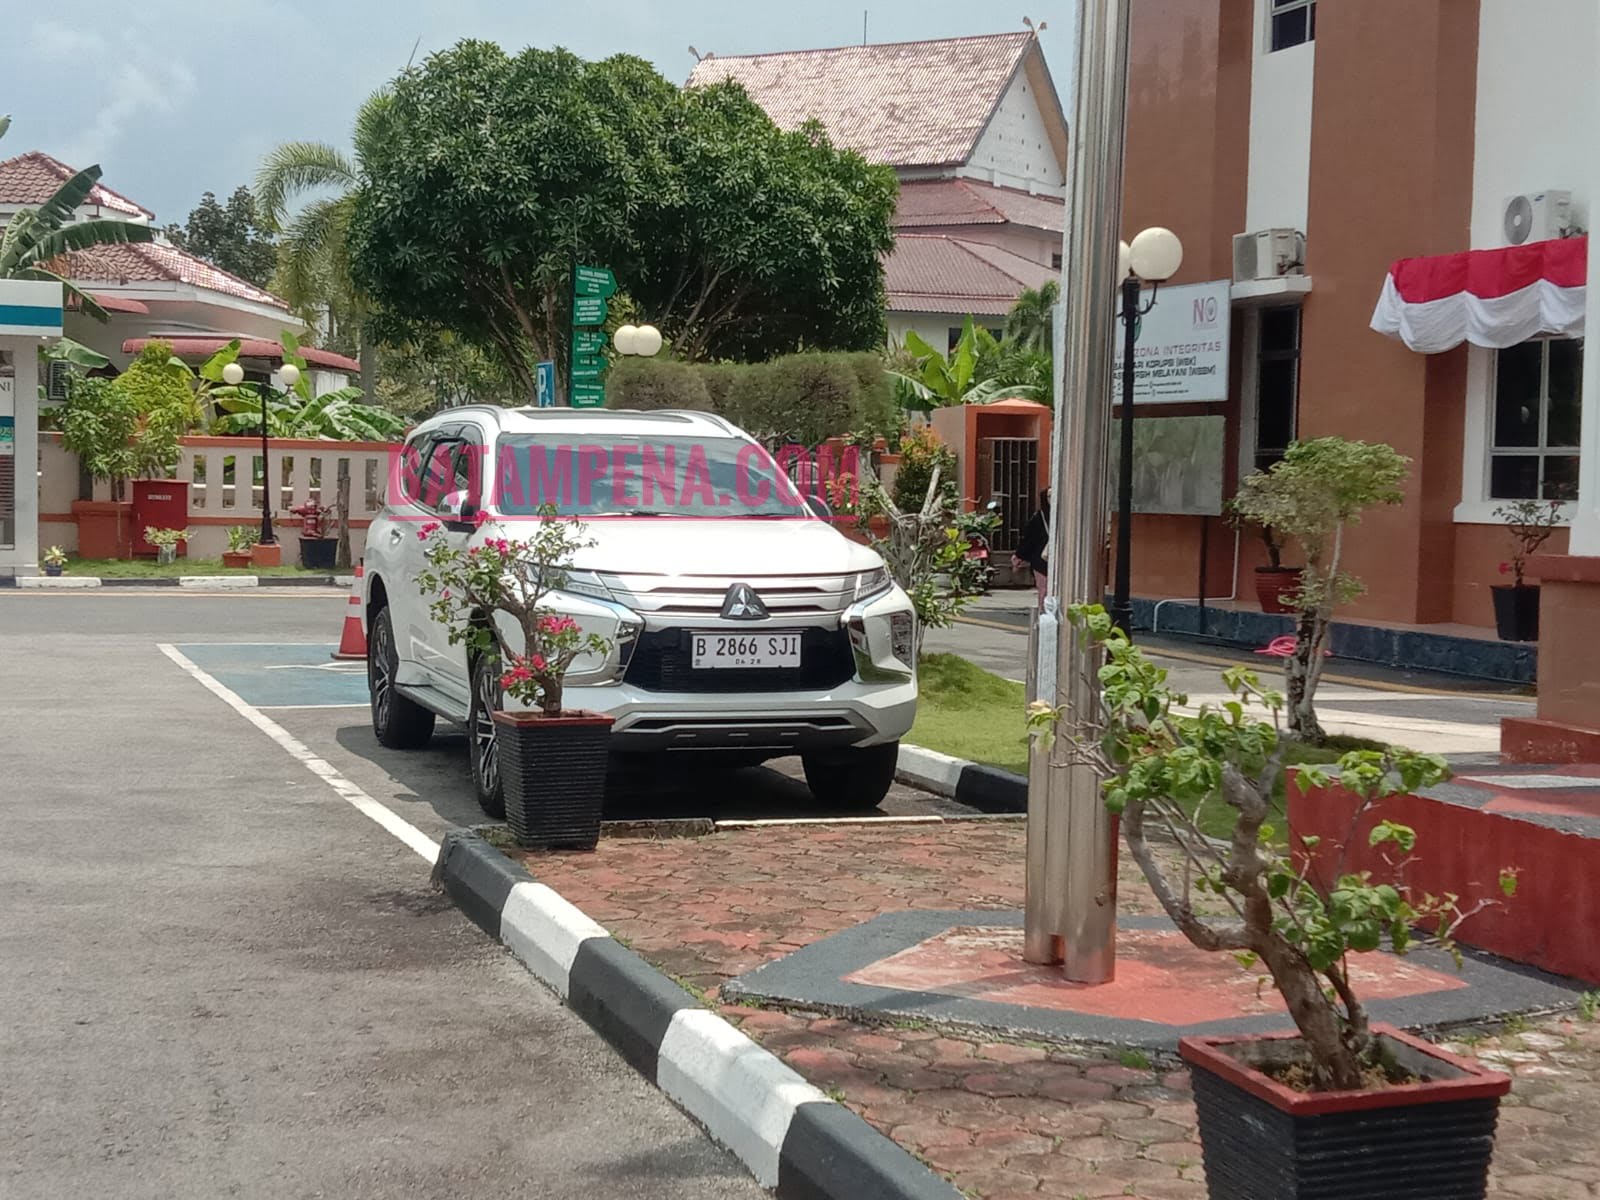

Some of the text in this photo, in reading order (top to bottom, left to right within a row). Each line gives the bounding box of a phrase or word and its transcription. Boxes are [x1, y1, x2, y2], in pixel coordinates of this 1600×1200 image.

[1163, 341, 1222, 356] INTEGRITAS
[696, 637, 797, 656] B 2866 SJI
